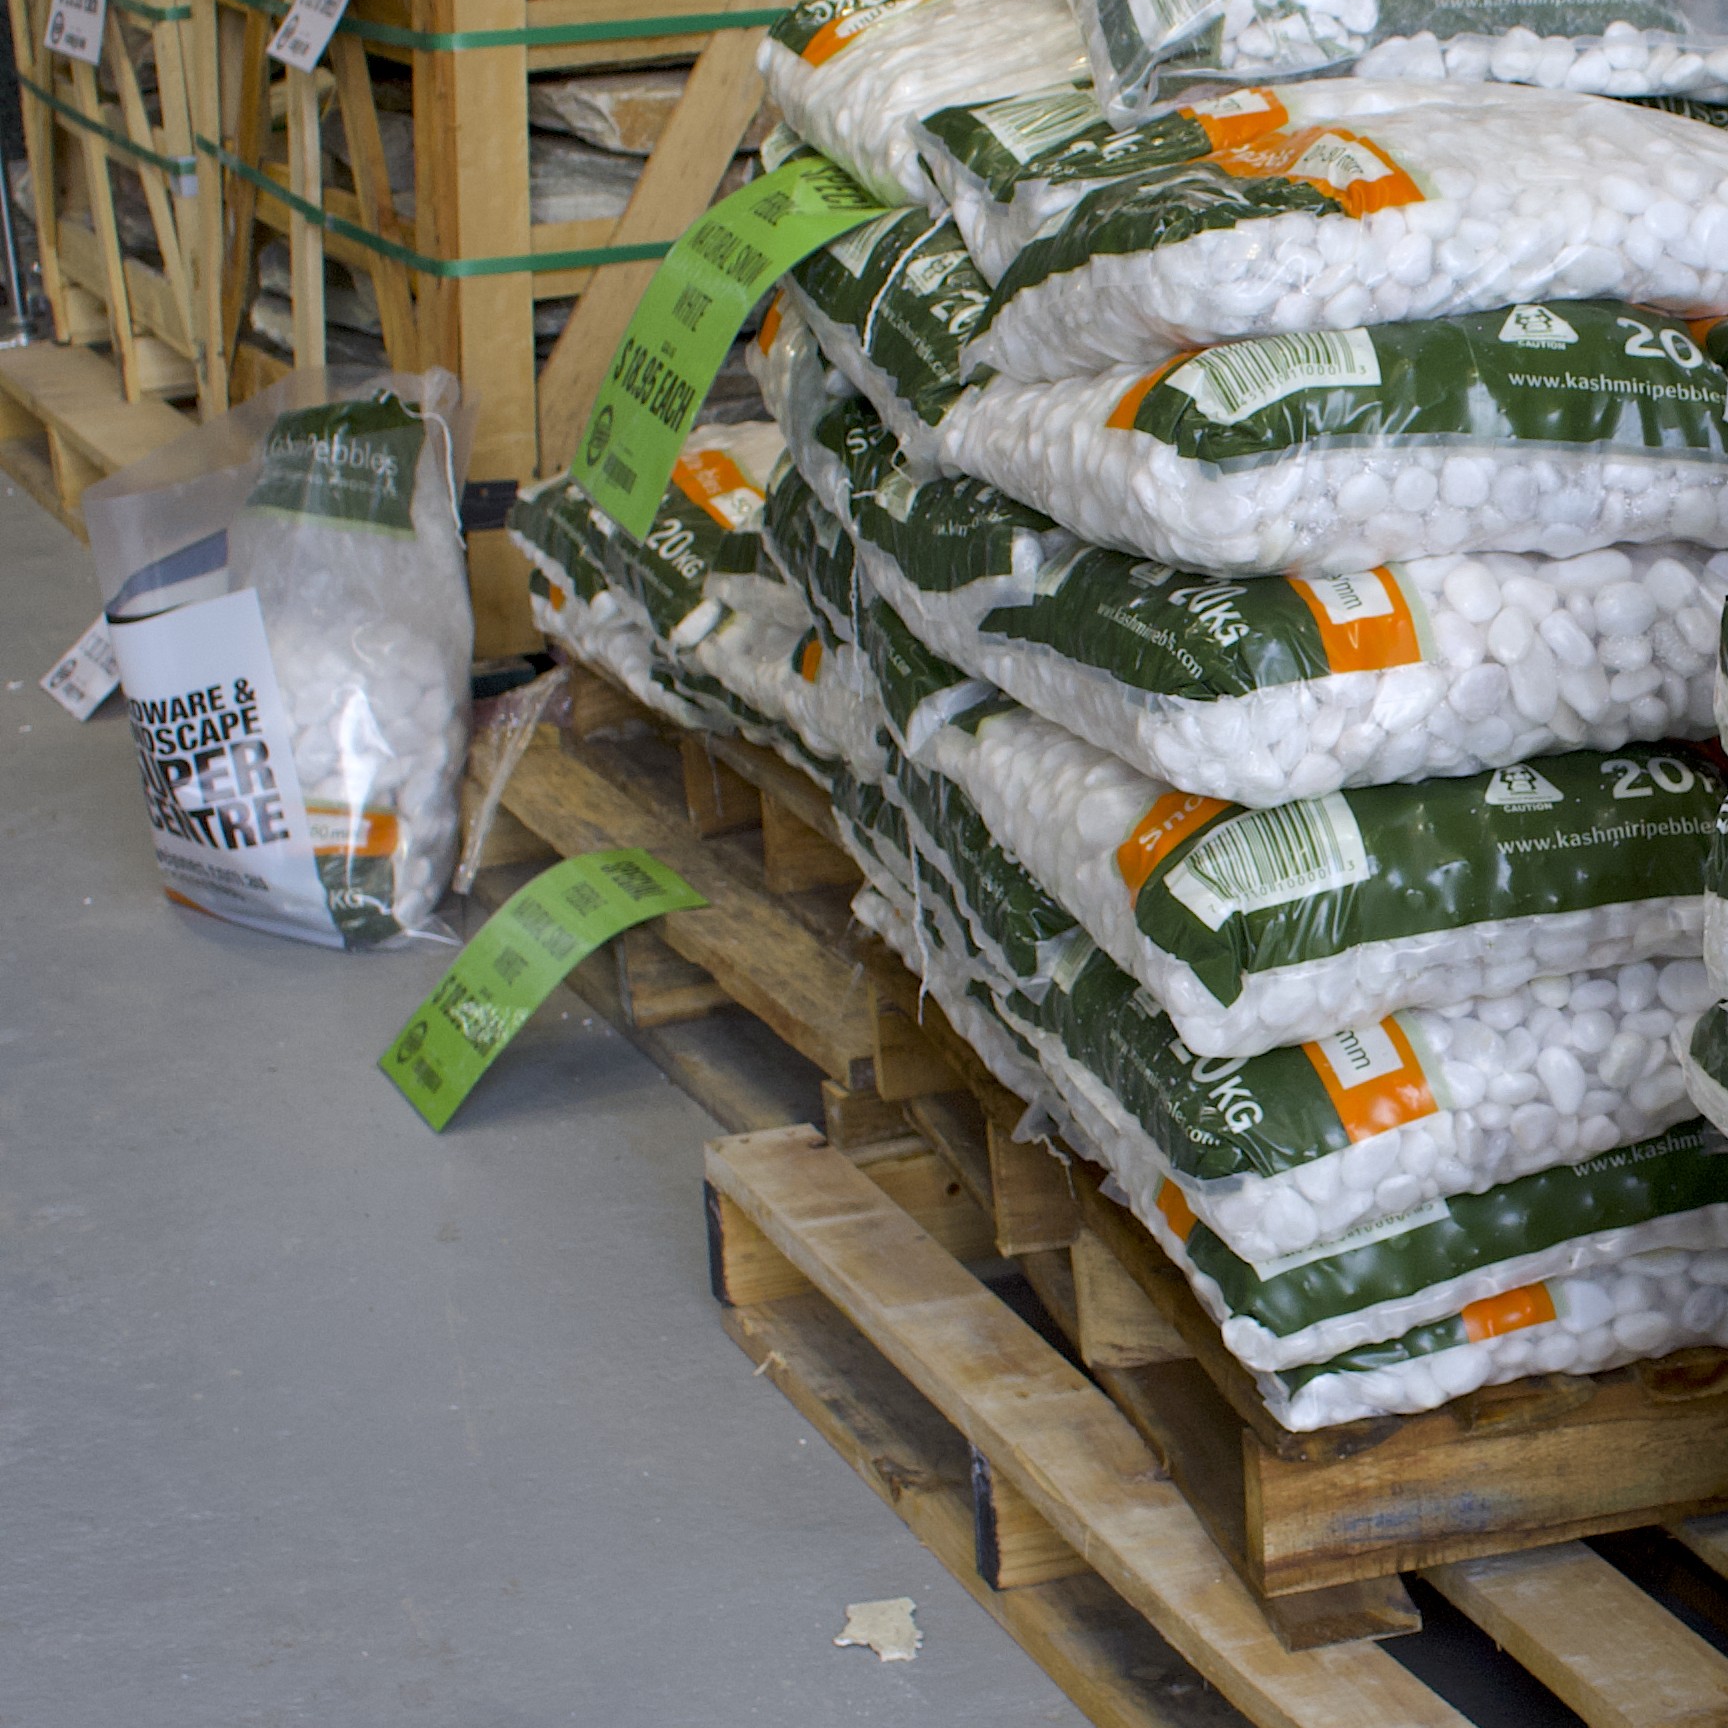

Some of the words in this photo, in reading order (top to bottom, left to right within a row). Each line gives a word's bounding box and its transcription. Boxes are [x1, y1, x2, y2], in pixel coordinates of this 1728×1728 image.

[1615, 315, 1710, 370] 20
[649, 367, 697, 433] EACH
[646, 518, 706, 577] 20KG
[233, 677, 257, 705] &
[1502, 800, 1555, 813] CAUTION
